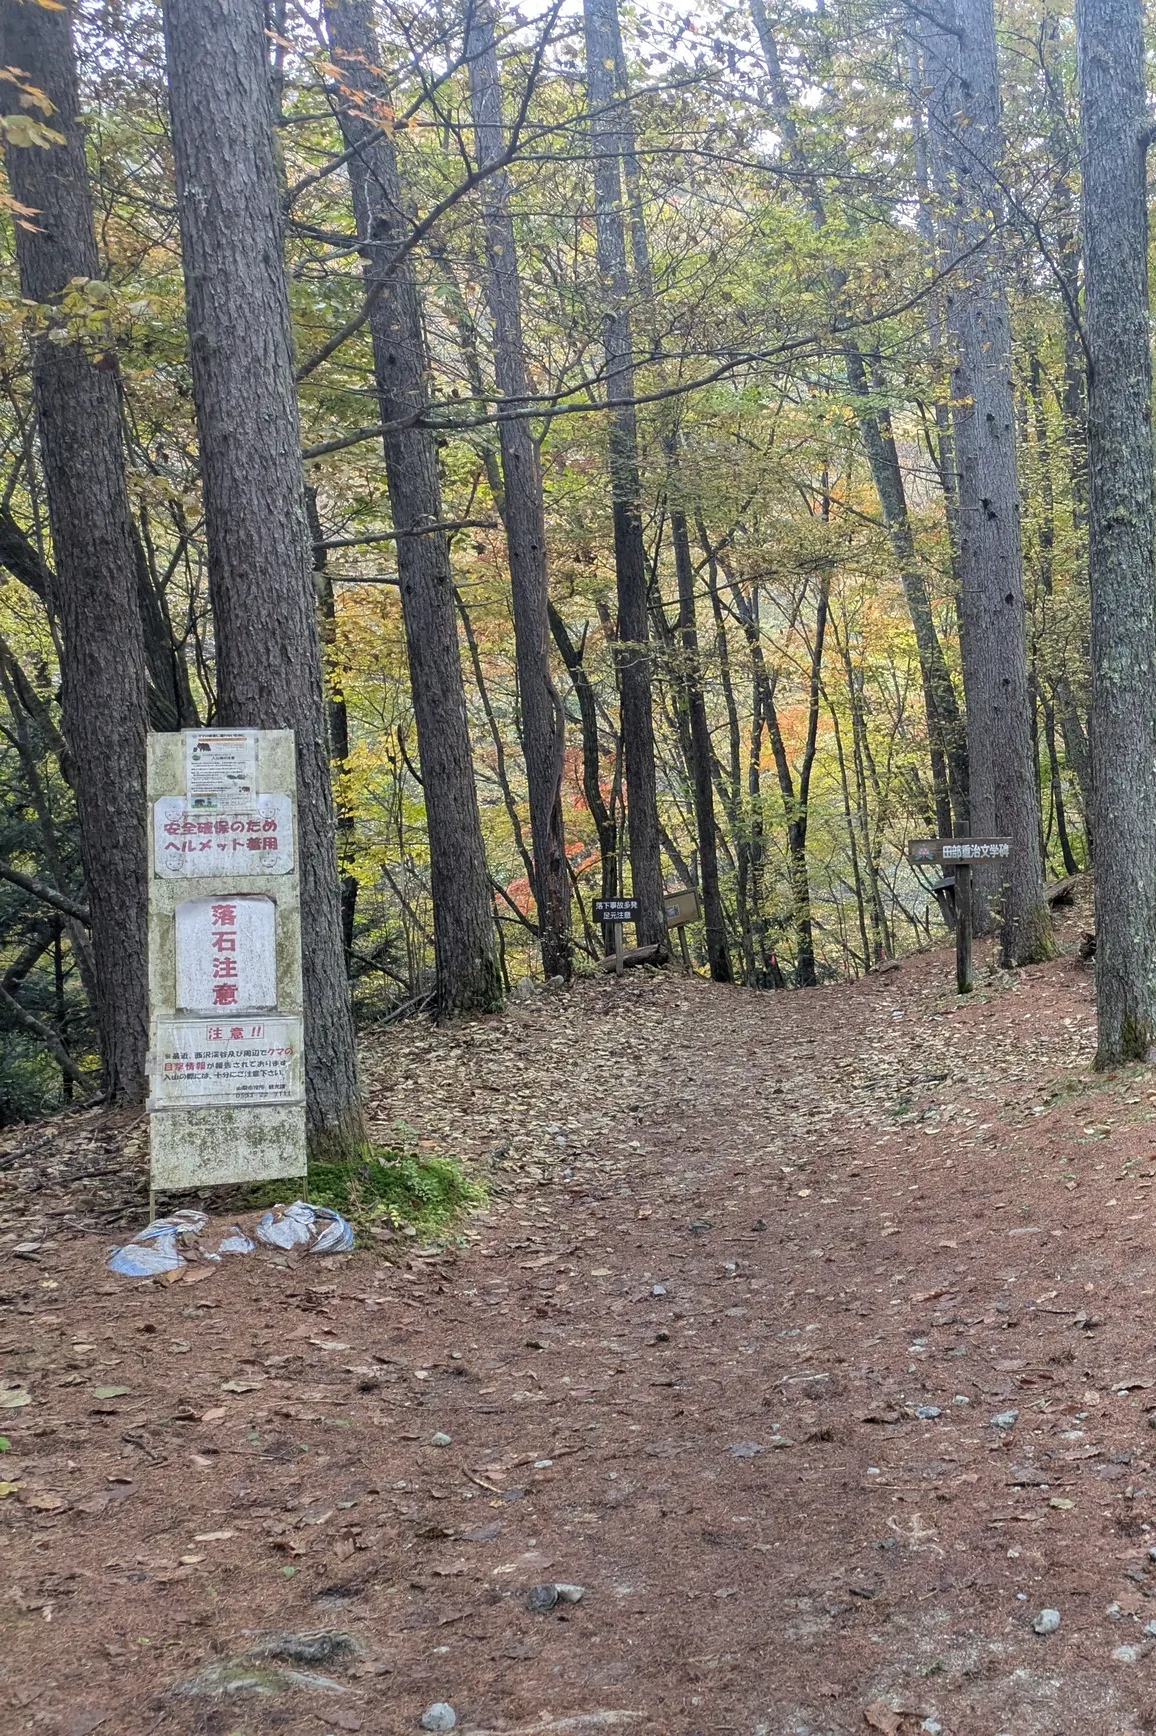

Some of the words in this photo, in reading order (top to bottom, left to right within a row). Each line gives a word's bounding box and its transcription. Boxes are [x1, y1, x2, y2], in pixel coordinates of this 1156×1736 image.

[163, 819, 278, 836] 安全確保のため
[164, 837, 278, 852] ヘルメット着用
[942, 843, 1010, 859] 田部重治文学碑
[595, 901, 638, 910] 落下事故多発
[603, 911, 632, 920] 足元注意
[211, 904, 239, 1006] 落石注意
